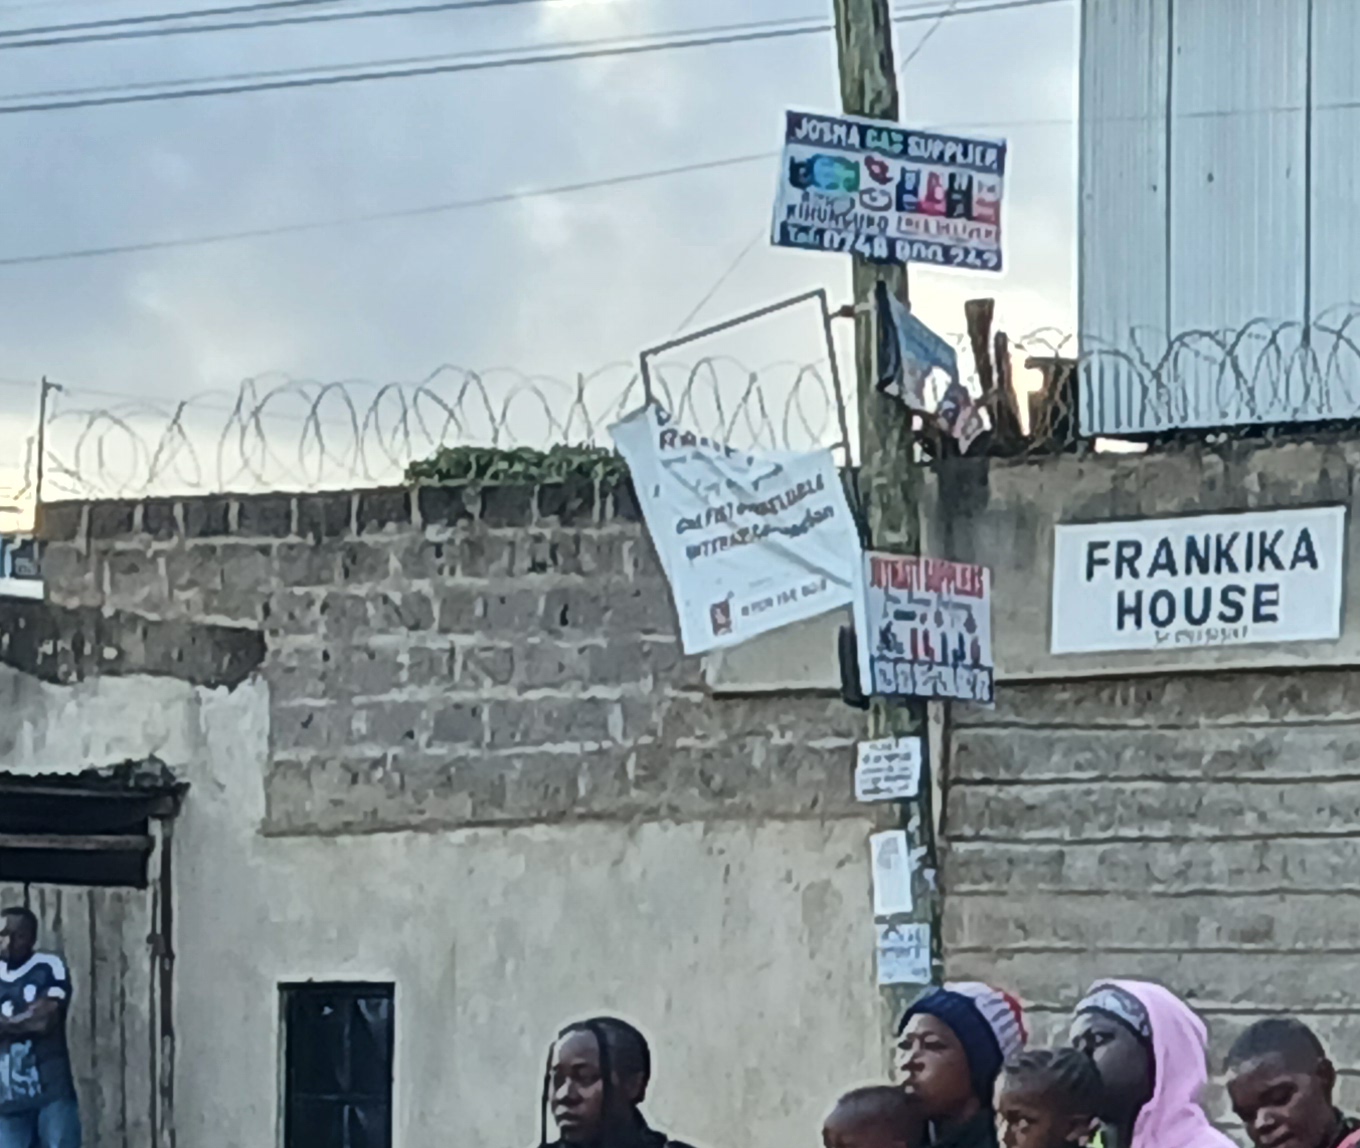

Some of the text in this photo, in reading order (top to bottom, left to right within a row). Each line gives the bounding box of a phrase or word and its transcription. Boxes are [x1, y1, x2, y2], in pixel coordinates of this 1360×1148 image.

[795, 116, 999, 170] JOSMA GAS SUPPLIER
[1085, 527, 1319, 582] FRANKIKA
[1116, 583, 1280, 631] HOUSE
